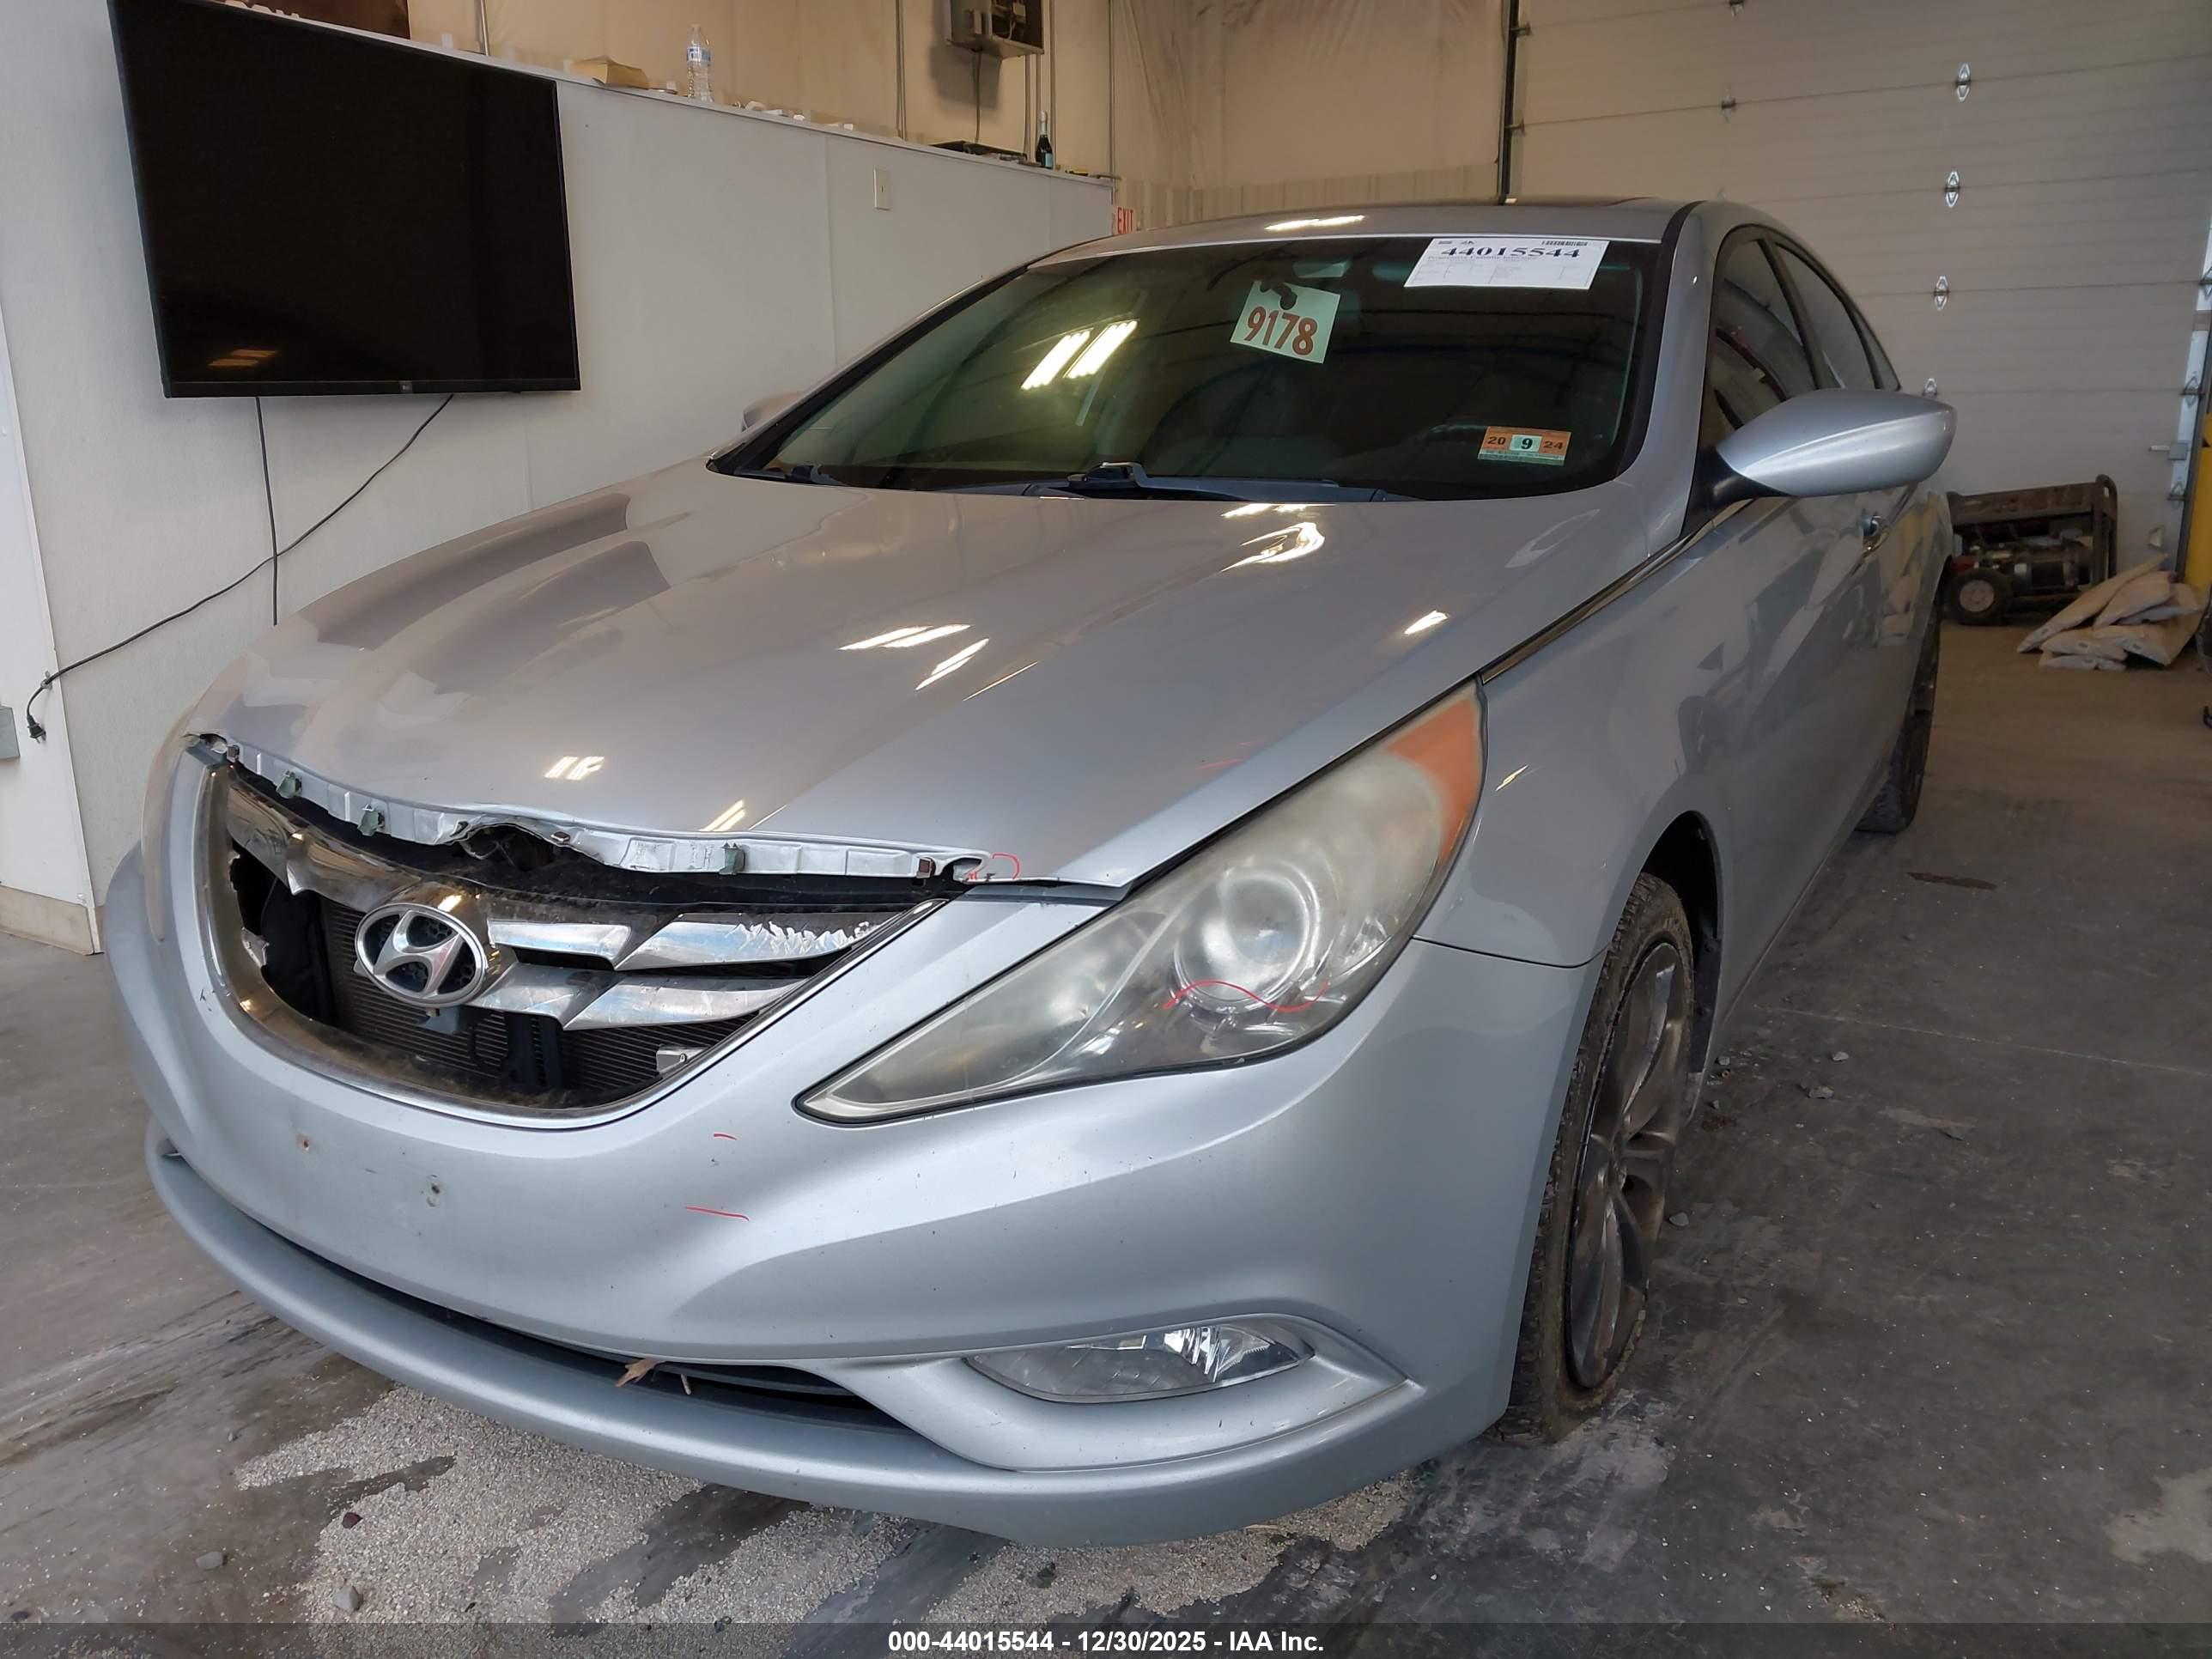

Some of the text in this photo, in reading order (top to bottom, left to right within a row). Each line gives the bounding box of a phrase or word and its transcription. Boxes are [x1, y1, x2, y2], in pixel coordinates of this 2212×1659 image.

[1117, 206, 1133, 234] EXIT
[1441, 246, 1580, 258] 44015544
[1243, 306, 1318, 356] 9178
[1487, 436, 1563, 450] 20 9 24
